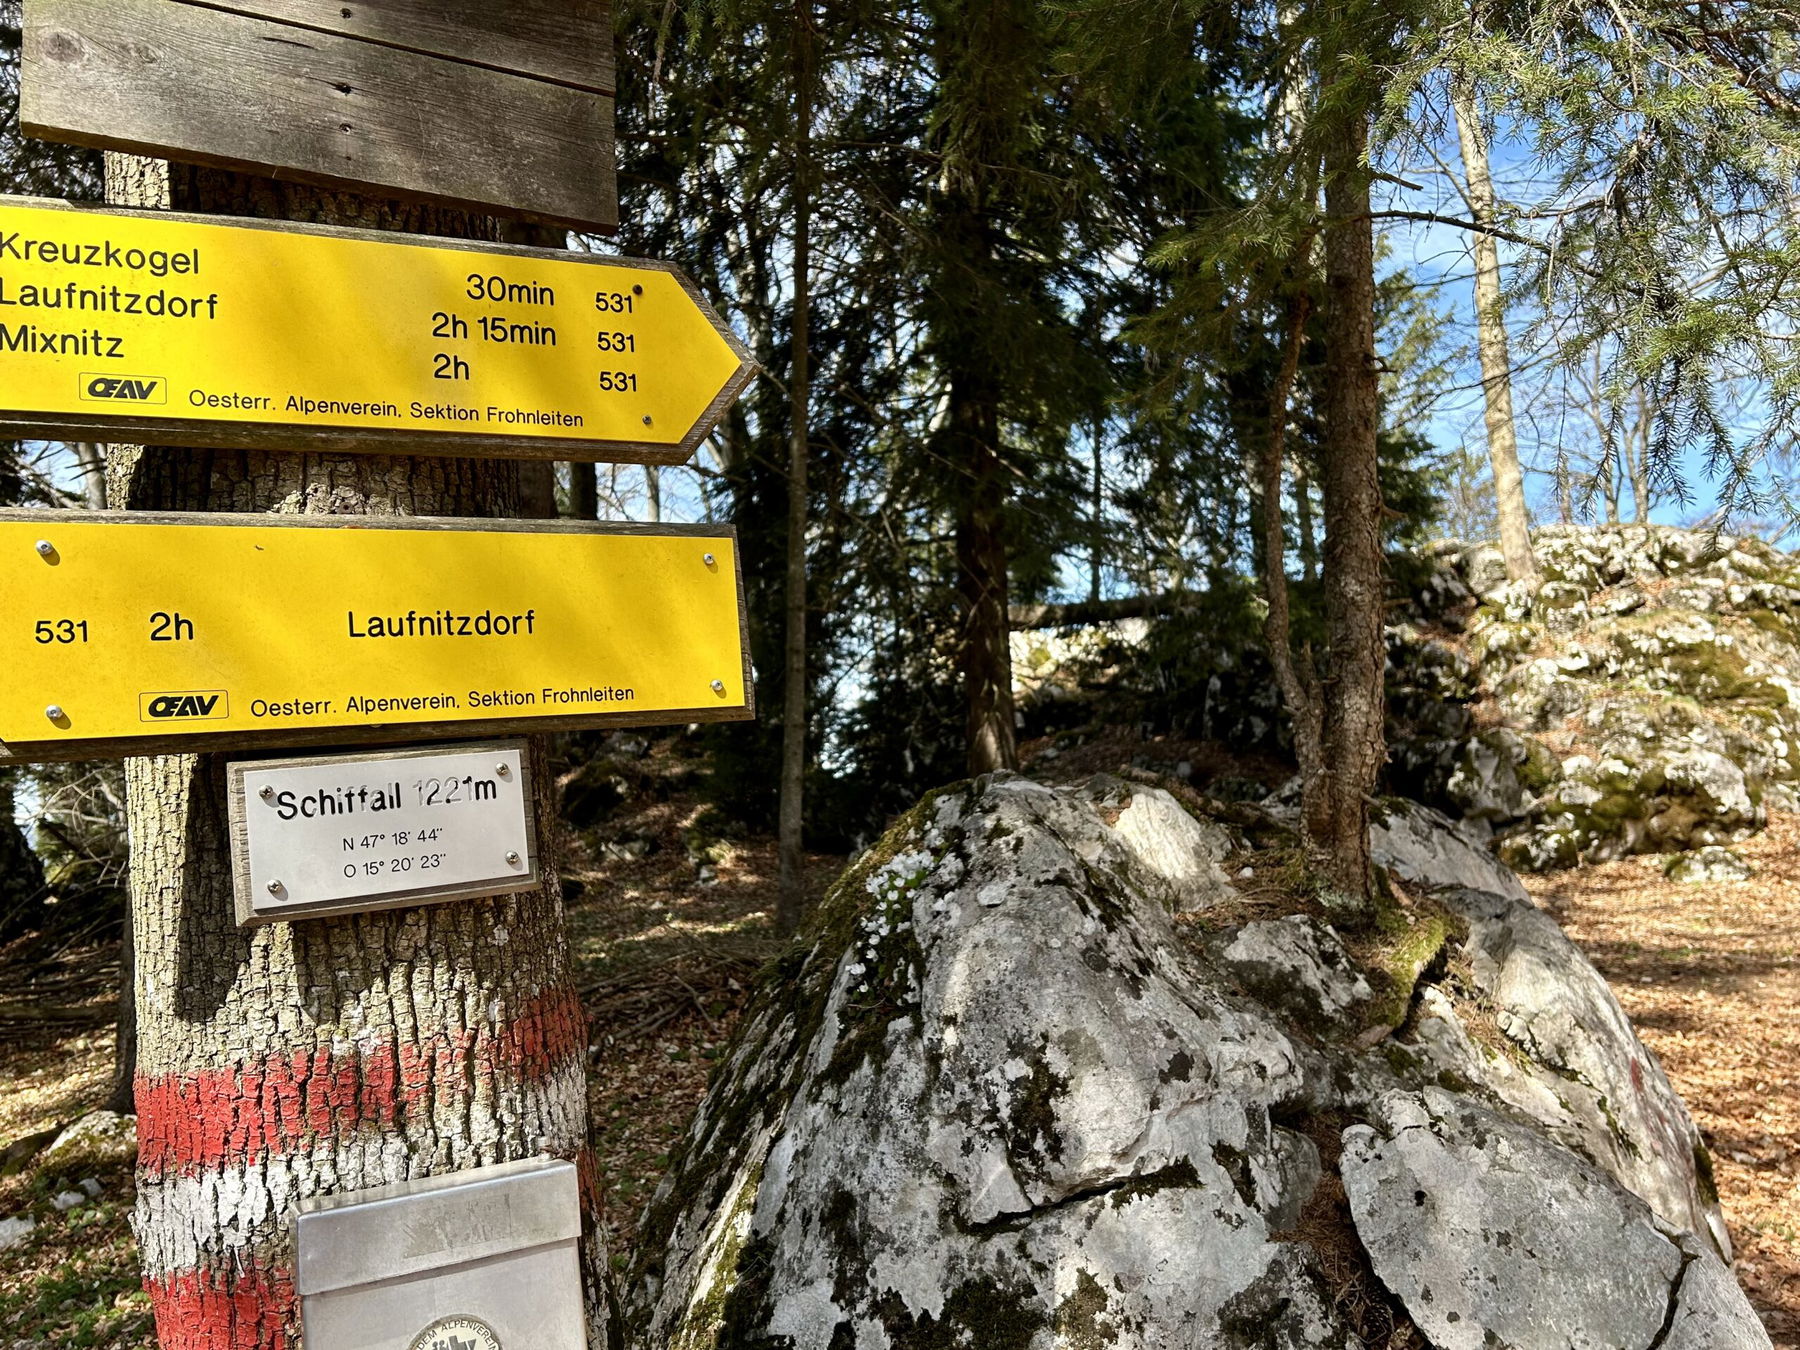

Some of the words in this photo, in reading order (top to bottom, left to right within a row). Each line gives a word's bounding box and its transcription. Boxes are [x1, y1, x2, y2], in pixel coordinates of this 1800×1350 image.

[0, 231, 200, 277] Kreuzkogel
[0, 278, 218, 319] Laufnitzdorf
[466, 273, 554, 306] 30min
[595, 292, 633, 314] 531
[0, 323, 124, 358] Mixnitz
[431, 312, 468, 339] 2h
[477, 317, 557, 346] 15min
[597, 332, 635, 353] 531
[433, 353, 470, 381] 2h
[599, 371, 637, 392] 531
[189, 390, 276, 410] Oesterr.
[410, 402, 479, 421] Sektion
[487, 407, 584, 427] Frohnleiten
[35, 620, 88, 643] 531
[149, 612, 194, 641] 2h
[348, 610, 535, 637] Laufnitzdorf
[250, 700, 337, 717] Oesterr.
[468, 690, 535, 707] Sektion
[542, 685, 634, 703] Frohnleiten
[277, 782, 401, 820] Schiffall
[413, 776, 497, 807] 1221m
[343, 838, 354, 851] N
[360, 834, 385, 849] 47°
[344, 864, 356, 878] O
[363, 861, 385, 875] 15°
